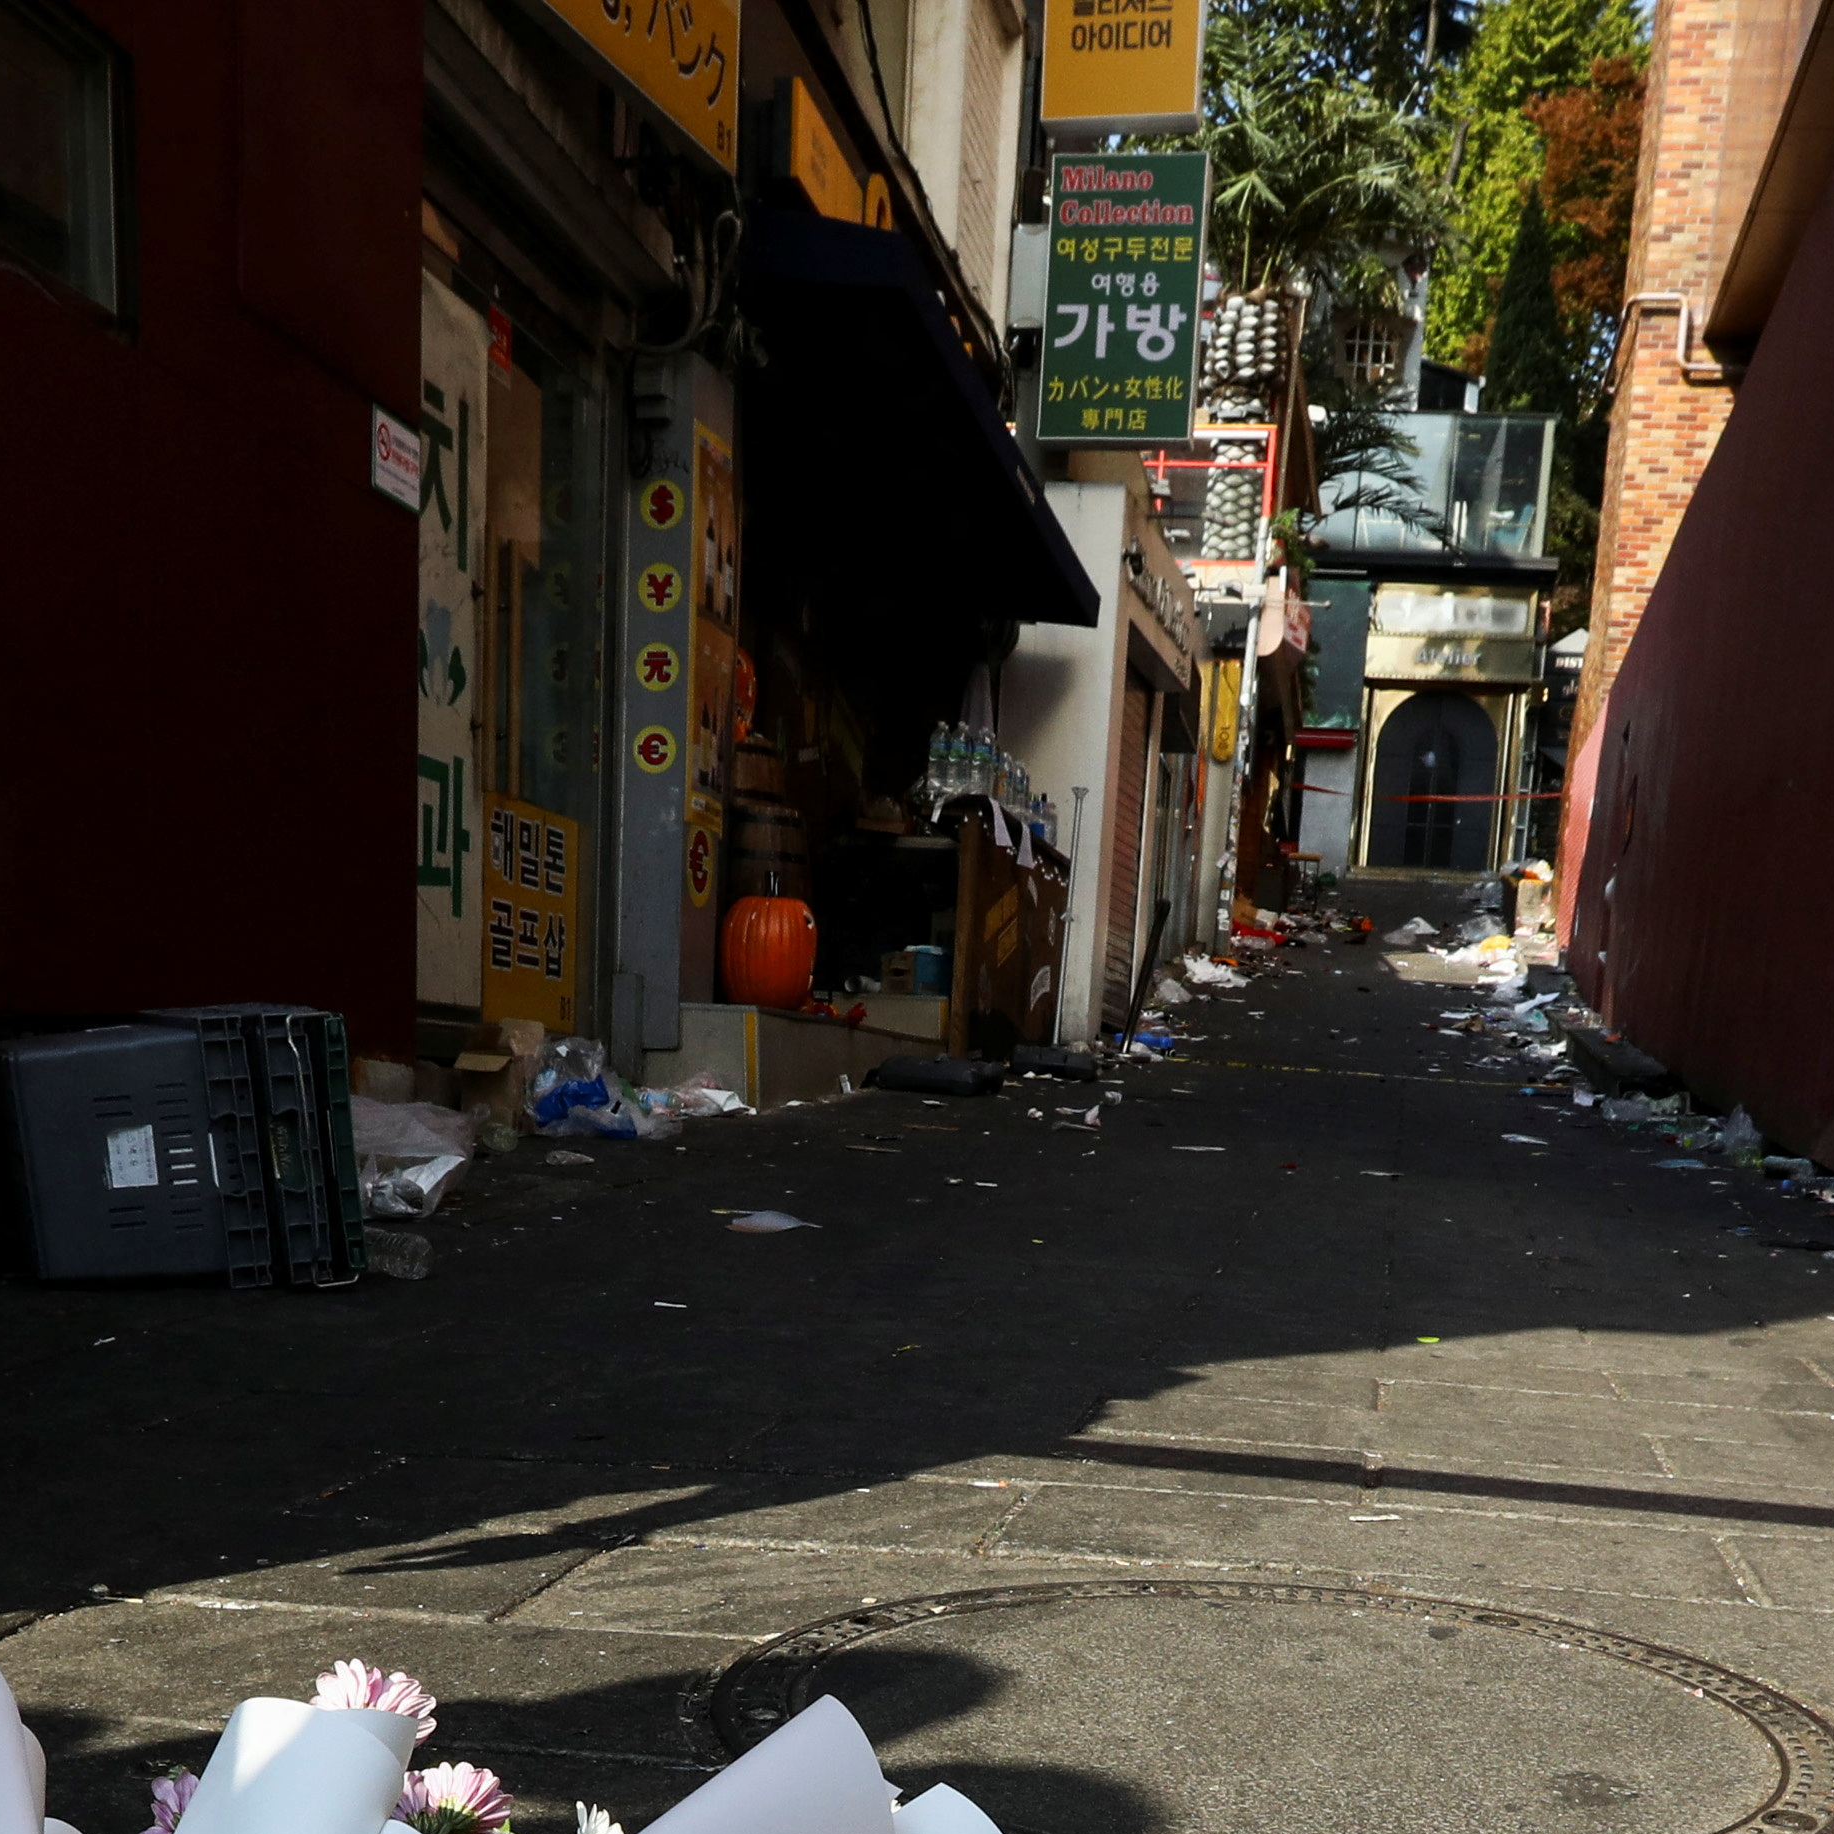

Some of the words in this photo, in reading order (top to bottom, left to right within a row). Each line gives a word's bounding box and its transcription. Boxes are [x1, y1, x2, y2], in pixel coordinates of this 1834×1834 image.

[1071, 18, 1173, 52] 아이디어
[1060, 165, 1154, 192] Milano
[1059, 198, 1195, 226] Collection
[1056, 235, 1195, 263] 여성구두전문
[1091, 271, 1161, 297] 여행용
[1054, 303, 1188, 362] 가방
[643, 651, 672, 683] 元
[1415, 643, 1482, 667] Atelier
[490, 809, 565, 894] 해밀톤
[489, 900, 565, 980] 골프샵
